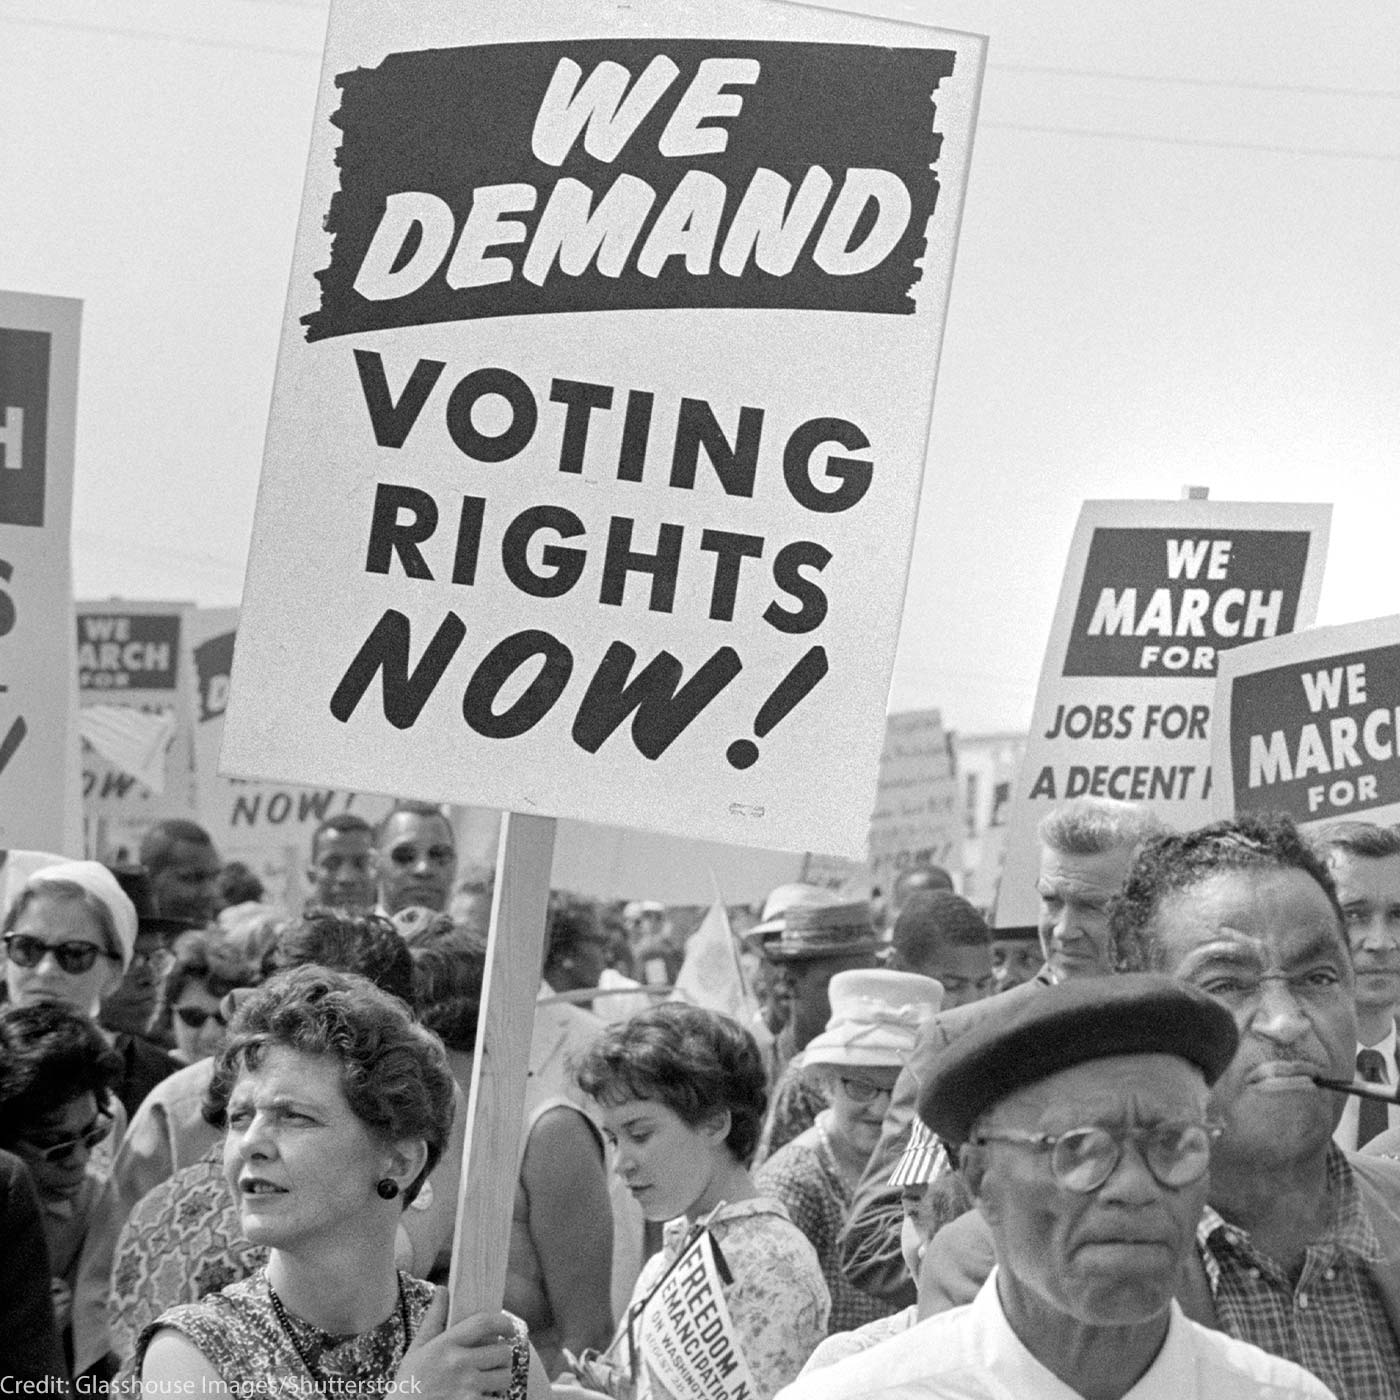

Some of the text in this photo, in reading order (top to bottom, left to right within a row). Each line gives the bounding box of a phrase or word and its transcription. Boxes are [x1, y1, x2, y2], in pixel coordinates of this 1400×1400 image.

[531, 55, 760, 166] WE
[353, 165, 912, 300] DEMAND
[353, 349, 873, 512] VOTING
[366, 482, 833, 634] RIGHTS
[1167, 539, 1232, 580] WE
[85, 618, 131, 642] WE
[1087, 587, 1283, 637] MARCH
[1140, 646, 1215, 670] FOR
[330, 608, 828, 769] NOW!
[1301, 663, 1366, 712] WE
[1044, 705, 1209, 739] JOBS FOR
[1029, 766, 1057, 799] A
[1065, 765, 1195, 799] DECENT
[1308, 774, 1378, 812] FOR
[679, 1244, 738, 1378] FREEDOM
